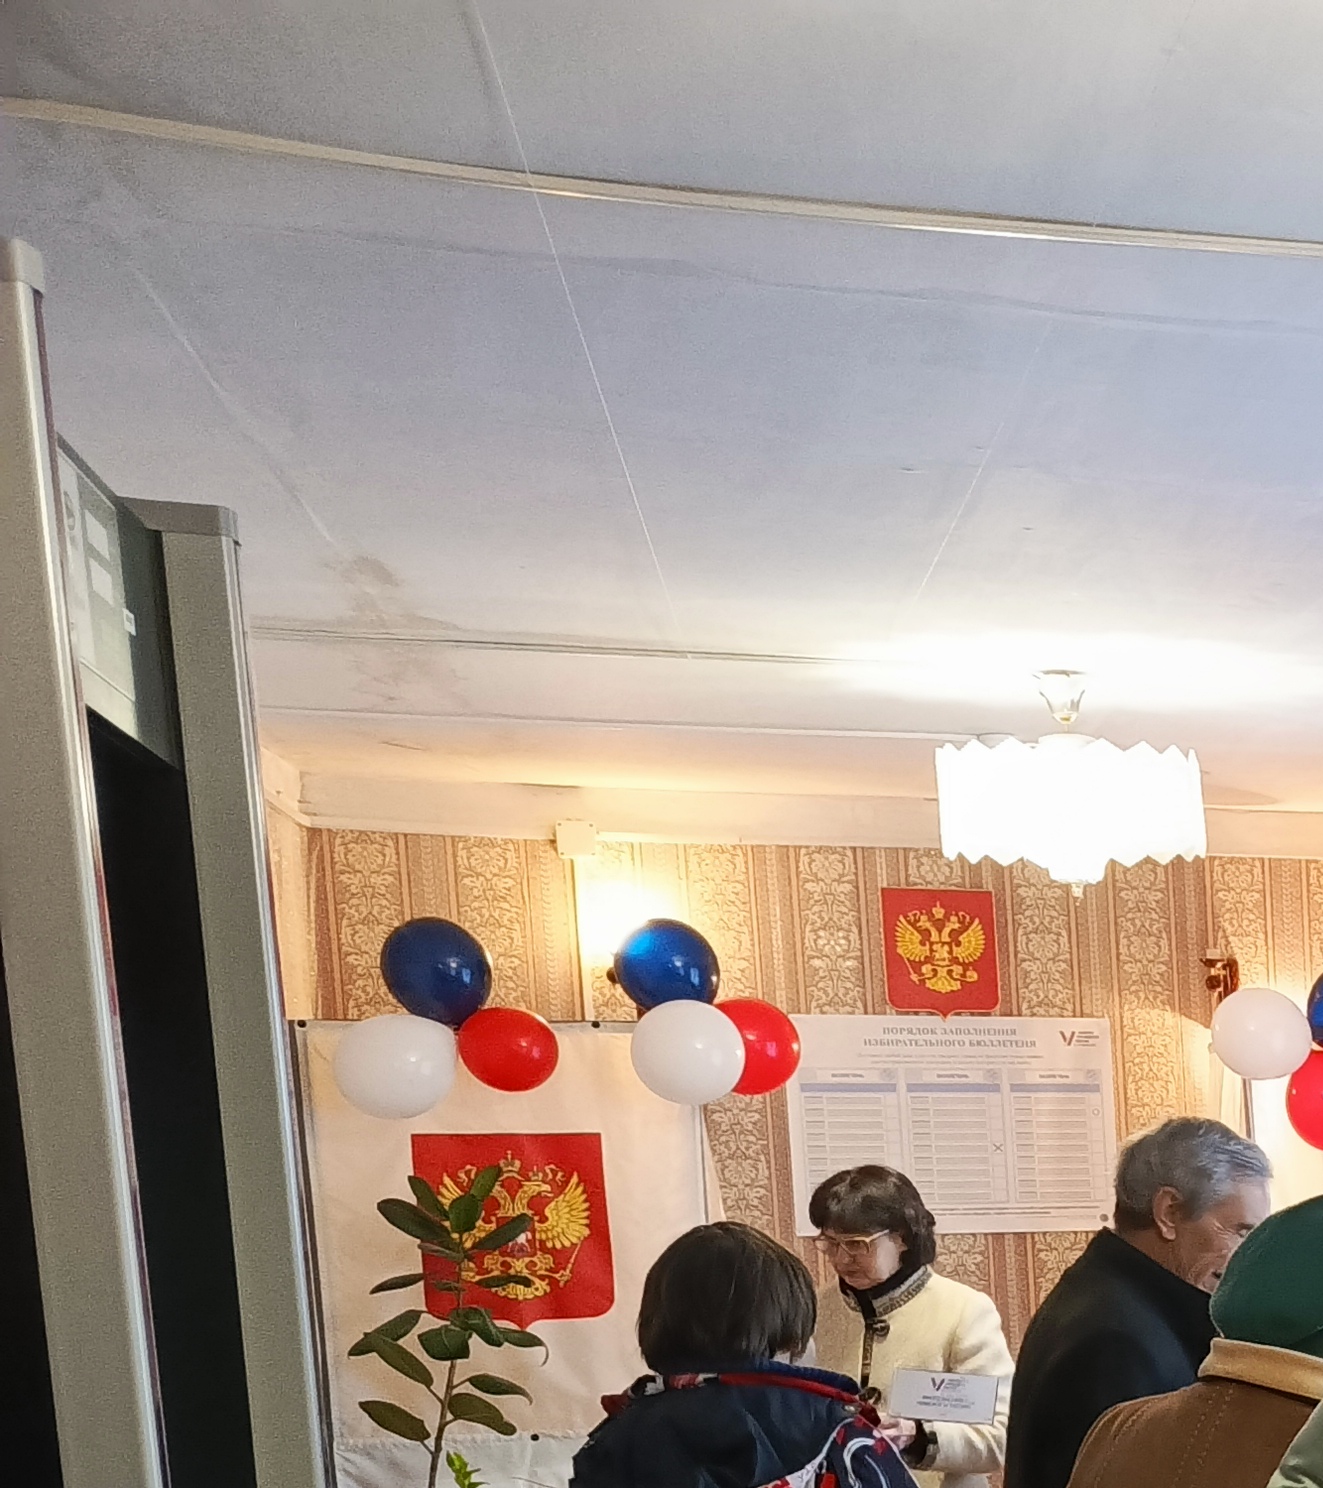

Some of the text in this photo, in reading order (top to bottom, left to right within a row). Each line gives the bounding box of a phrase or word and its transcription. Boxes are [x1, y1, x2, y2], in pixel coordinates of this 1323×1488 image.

[882, 1027, 1017, 1036] ПОРЯДОК ЗАПОЛНЕНИЯ
[863, 1038, 1037, 1048] ИЗБИРАТЕЛЬНОГО БЮЛЛЕТЕНЯ
